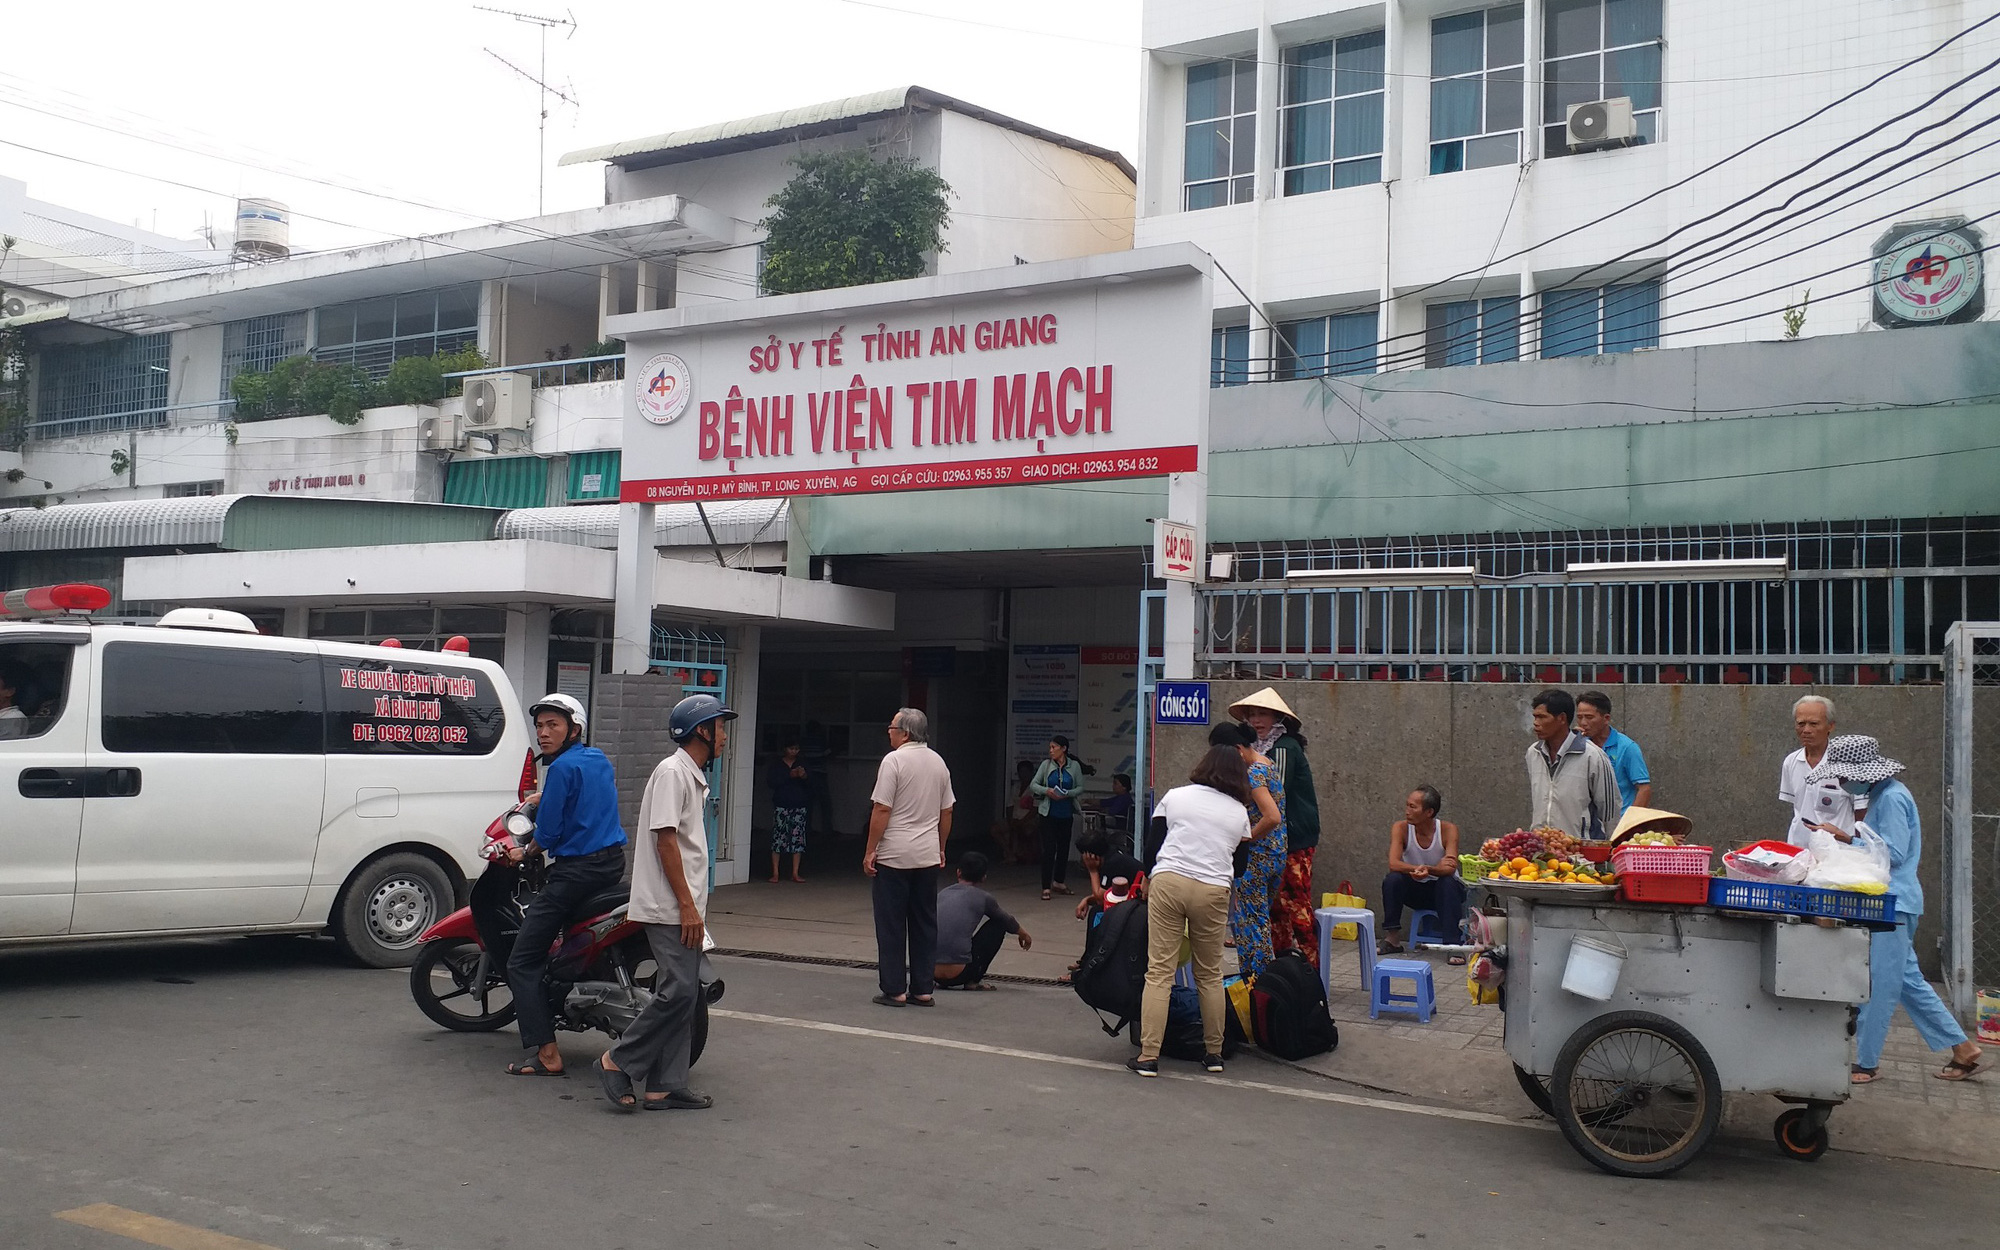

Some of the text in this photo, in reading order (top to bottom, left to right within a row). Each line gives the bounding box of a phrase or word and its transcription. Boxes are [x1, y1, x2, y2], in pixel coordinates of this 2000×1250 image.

[1914, 307, 1942, 317] 1991
[749, 313, 1058, 373] SỞ Y TẾ TỈNH AN GIANG
[698, 364, 1113, 472] BỆNH VIỆN TIM MẠCH
[870, 473, 889, 488] GỌI
[892, 468, 913, 485] CẤP
[915, 468, 940, 484] CỨU:
[994, 466, 1013, 479] 357
[1021, 464, 1049, 477] GIAO
[1052, 462, 1080, 478] DỊCH:
[1138, 456, 1159, 471] 832
[323, 475, 337, 488] AN
[647, 475, 858, 498] 08 NGUYỄN DU, P. MỸ BÌNH, TP. LONG XUYÊN, AG
[1165, 527, 1178, 559] CẤP
[340, 665, 476, 701] XE CHUYỂN BỆNH TỪ THIỆN
[374, 694, 441, 722] XÃ BÌNH PHÚ
[1160, 687, 1206, 718] CỔNG SỐ 1
[353, 723, 468, 743] ĐT: 0962 023 052
